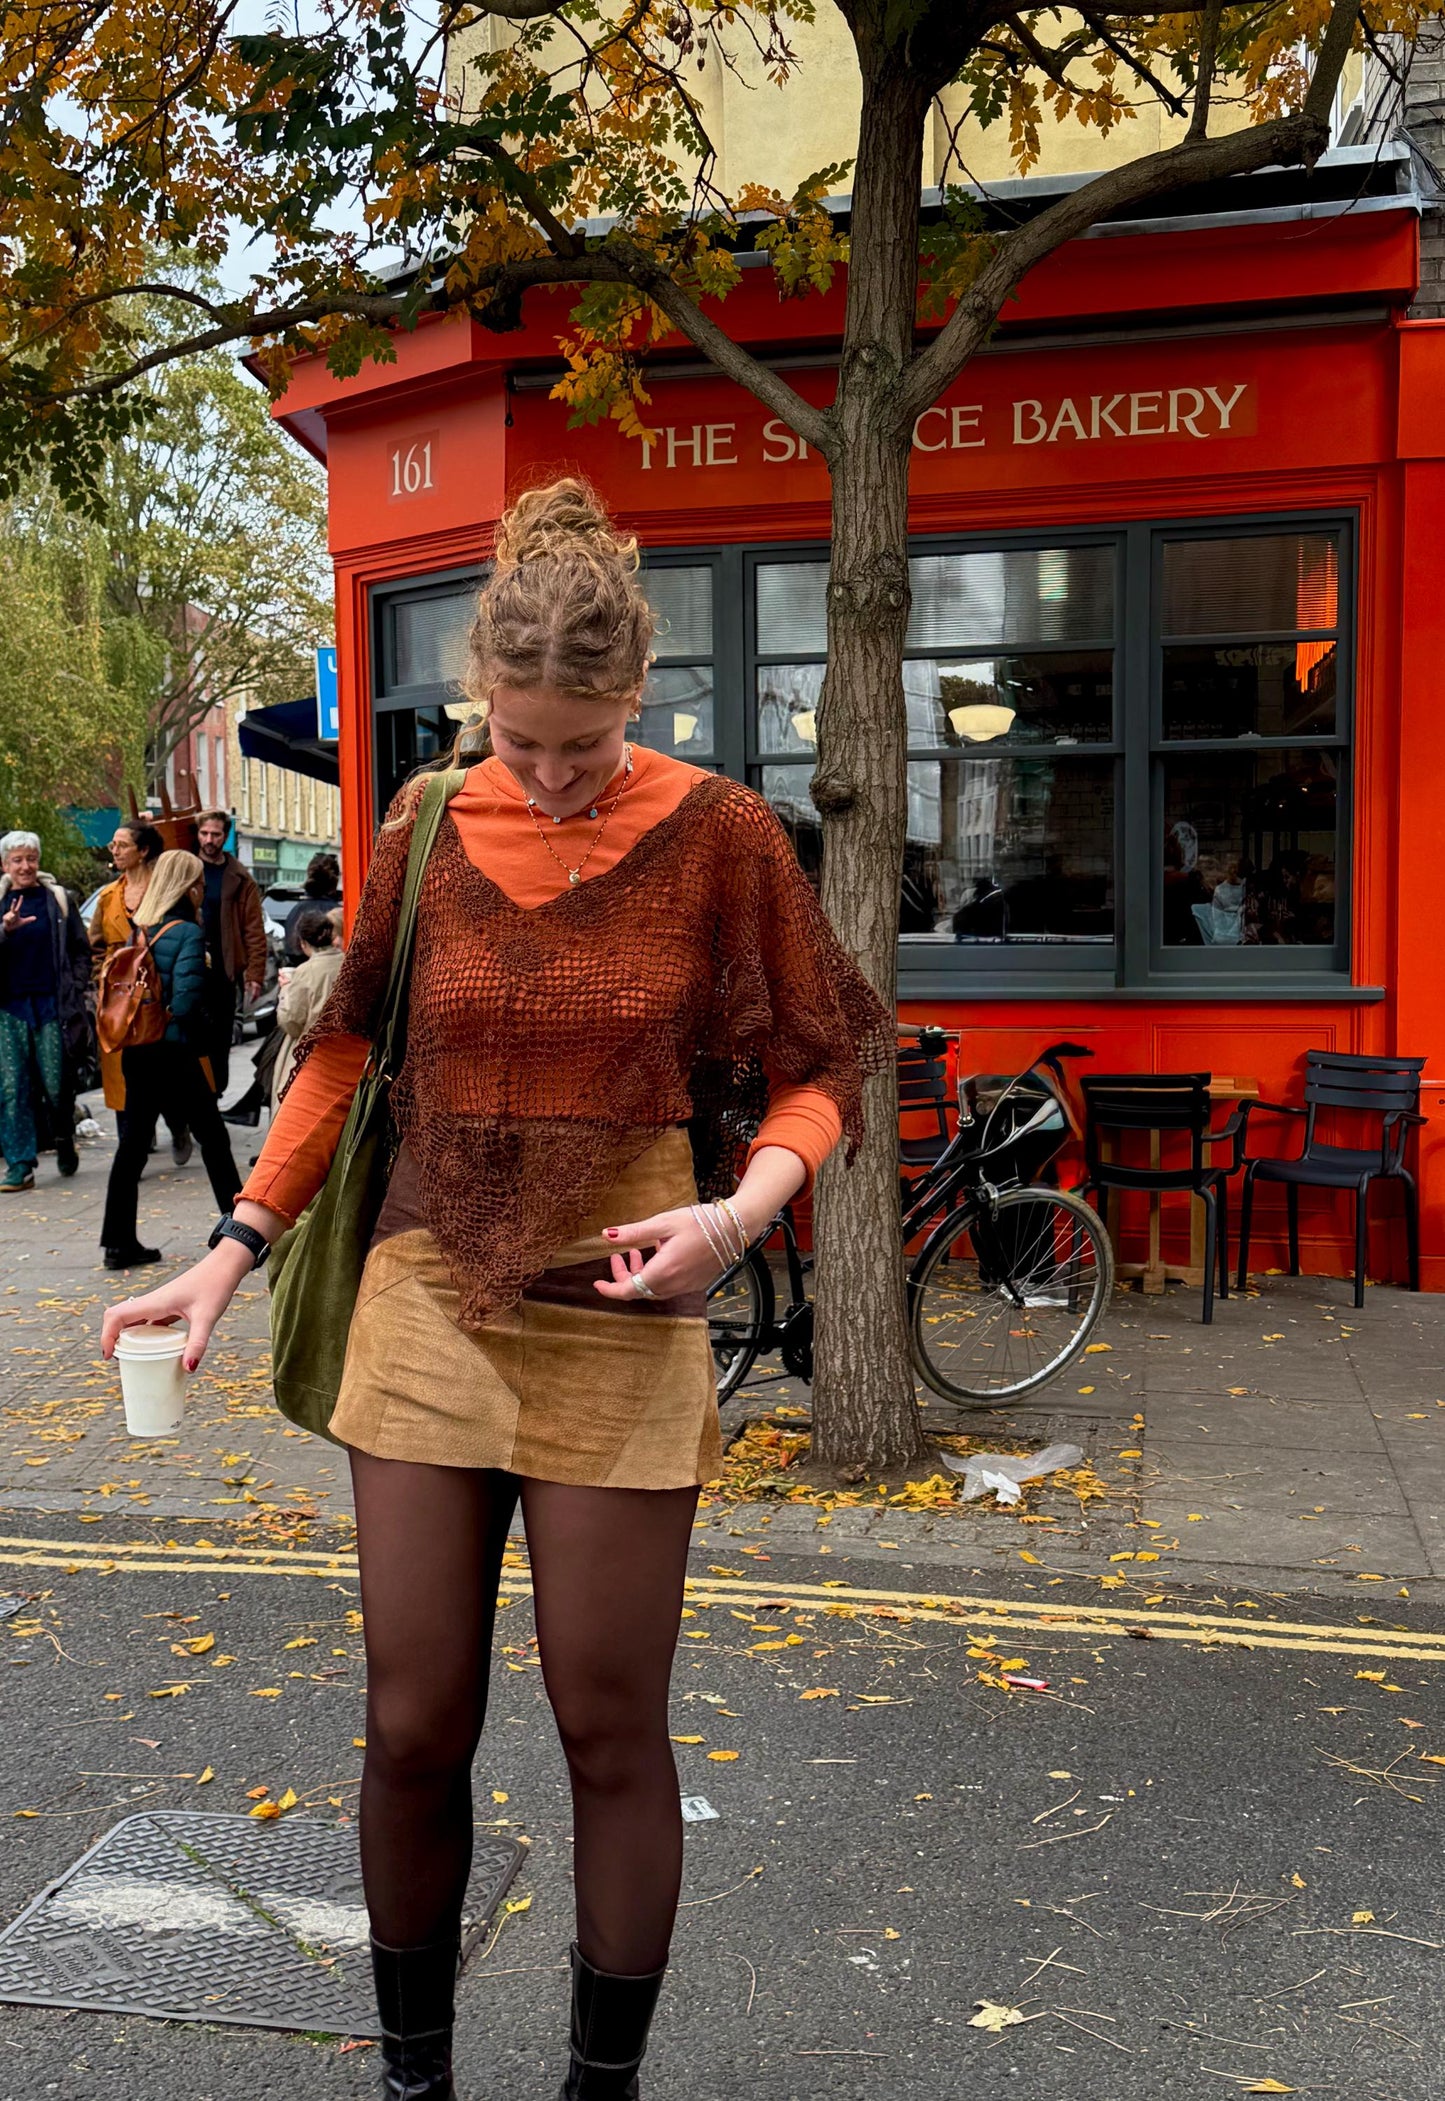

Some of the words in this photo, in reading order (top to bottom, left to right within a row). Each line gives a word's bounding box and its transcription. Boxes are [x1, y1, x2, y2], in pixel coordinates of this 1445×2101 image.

[641, 423, 738, 469] THE
[1012, 384, 1248, 445] BAKERY
[392, 440, 433, 496] 161
